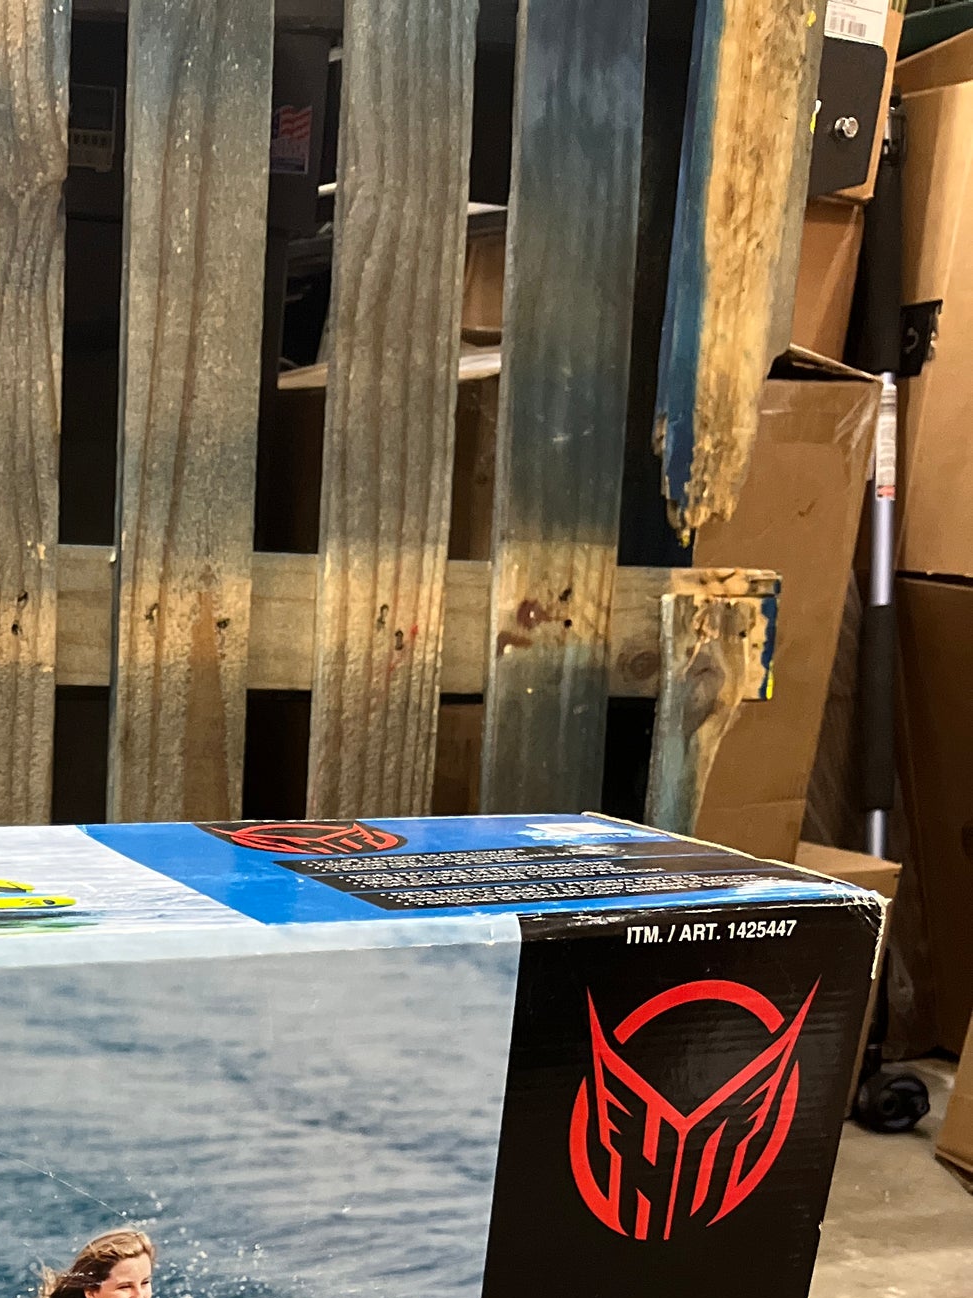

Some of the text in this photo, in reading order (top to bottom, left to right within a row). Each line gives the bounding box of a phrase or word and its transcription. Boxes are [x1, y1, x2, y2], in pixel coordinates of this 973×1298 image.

[627, 919, 798, 945] ITM. / ART. 1425447
